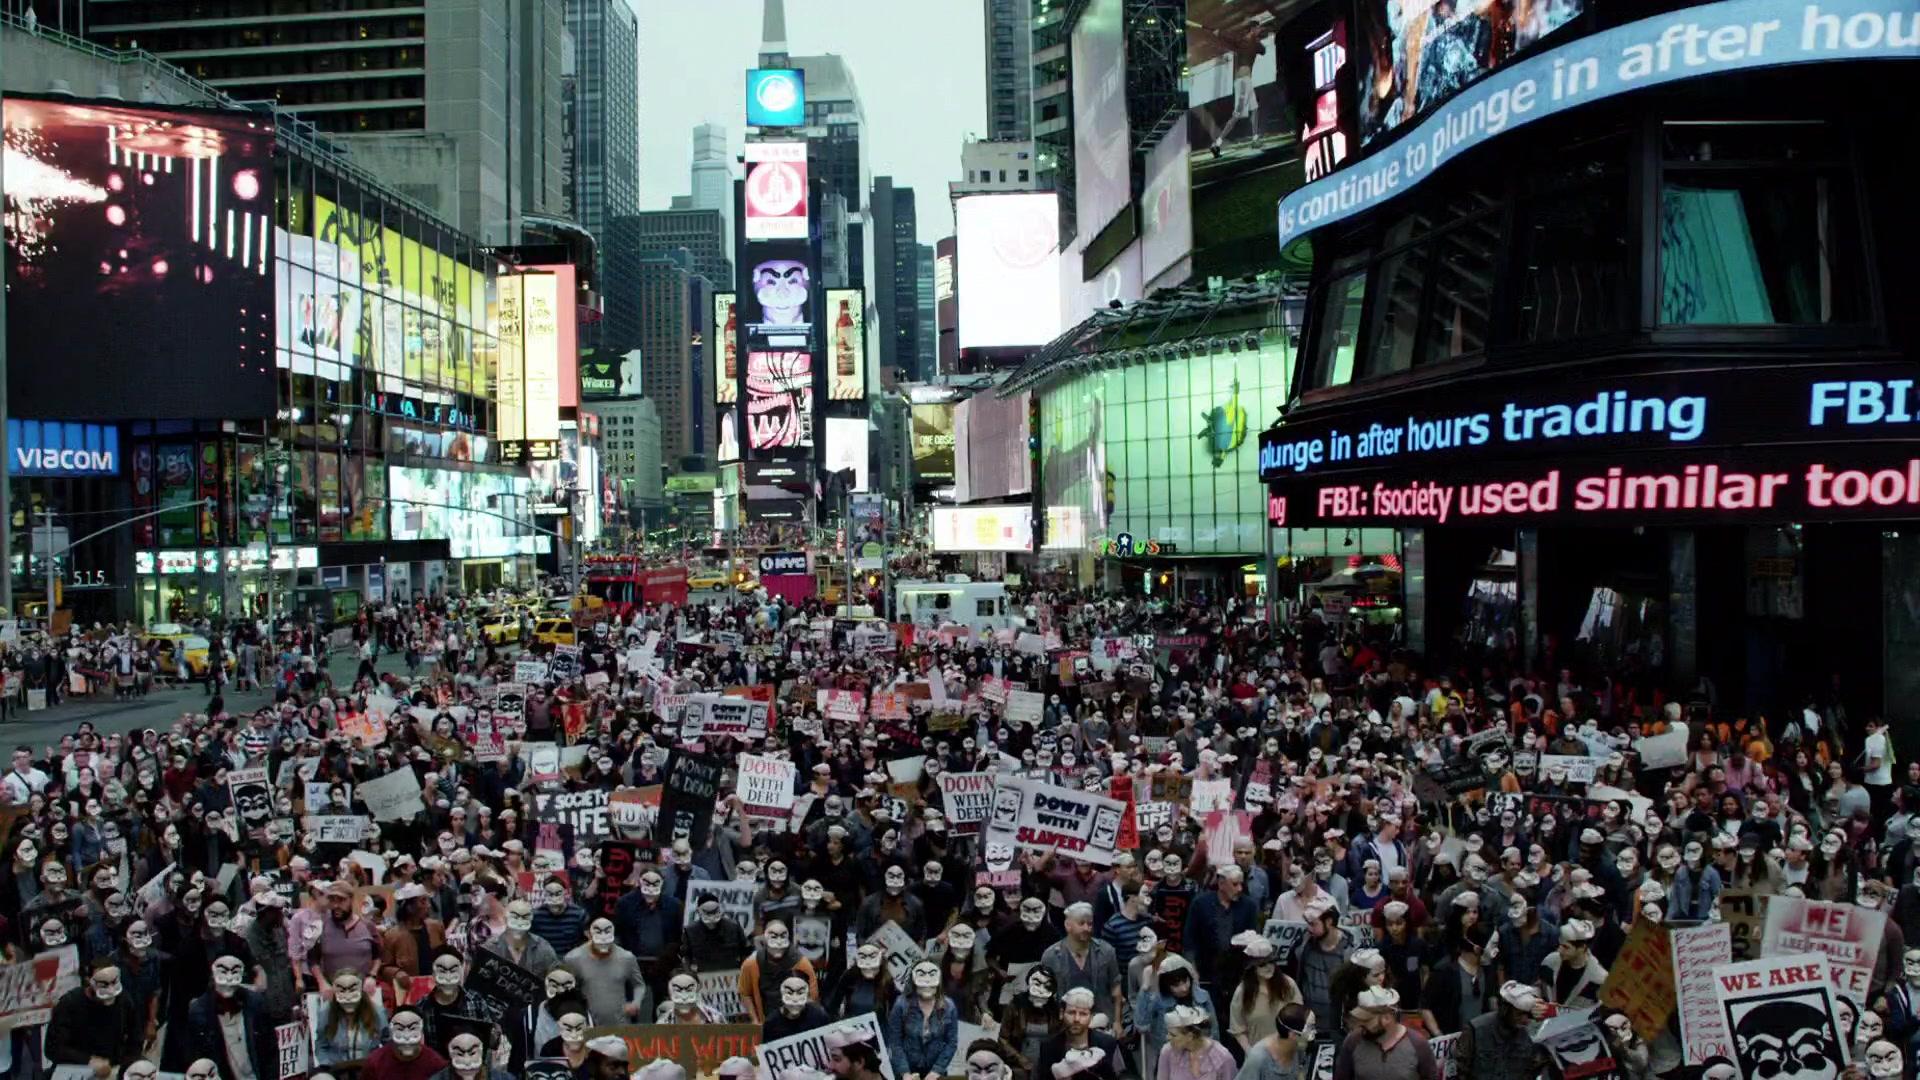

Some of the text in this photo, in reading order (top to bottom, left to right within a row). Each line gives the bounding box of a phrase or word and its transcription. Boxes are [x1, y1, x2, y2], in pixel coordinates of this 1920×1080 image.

[1299, 159, 1400, 226] continue
[1405, 144, 1426, 177] to
[1431, 79, 1537, 170] plunge
[1553, 57, 1599, 101] in
[1618, 20, 1781, 81] after
[1259, 438, 1324, 475] plunge
[1330, 430, 1351, 461] in
[1357, 423, 1404, 459] after
[1407, 413, 1491, 452] hours
[1502, 390, 1707, 441] trading
[1318, 486, 1368, 518] FBI:
[1373, 480, 1454, 524] fsociety
[1460, 470, 1560, 515] used
[1574, 464, 1789, 511] similar
[73, 570, 106, 586] 515
[743, 757, 791, 779] DOWN
[748, 776, 784, 792] WITH
[944, 775, 996, 793] DOWN
[953, 792, 991, 808] WITH
[1034, 792, 1090, 817] DOWN
[956, 806, 992, 821] DEBT
[1036, 812, 1081, 832] WITH
[1720, 963, 1823, 993] WE ARE
[690, 1035, 762, 1060] WITH
